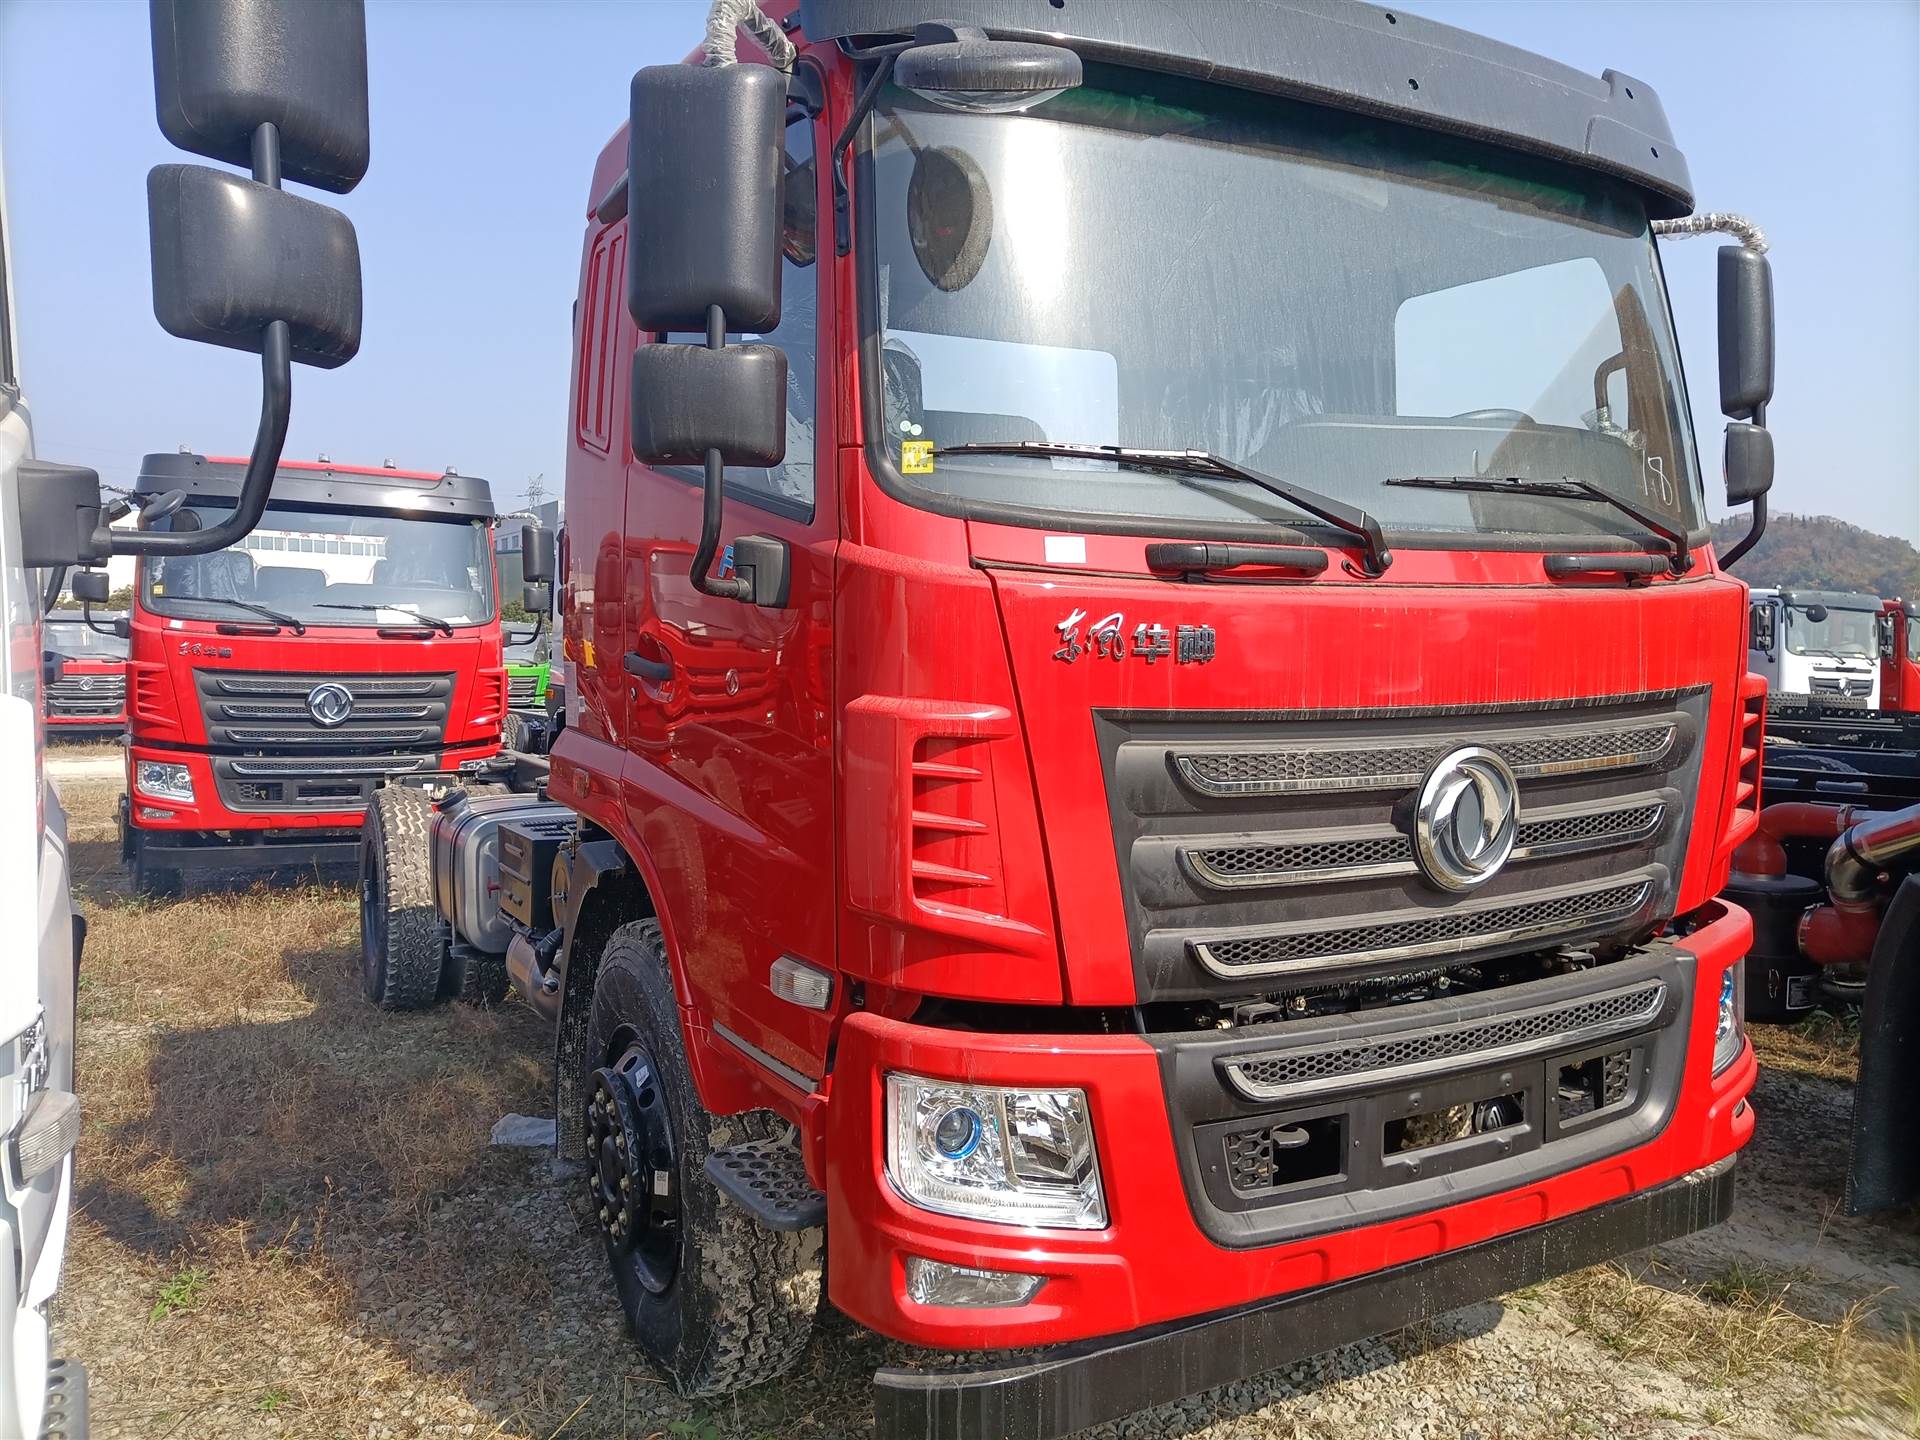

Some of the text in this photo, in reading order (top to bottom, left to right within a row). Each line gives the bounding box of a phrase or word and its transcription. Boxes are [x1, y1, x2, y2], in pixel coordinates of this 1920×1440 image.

[1642, 449, 1673, 506] 18
[1053, 607, 1216, 663] 东风华神
